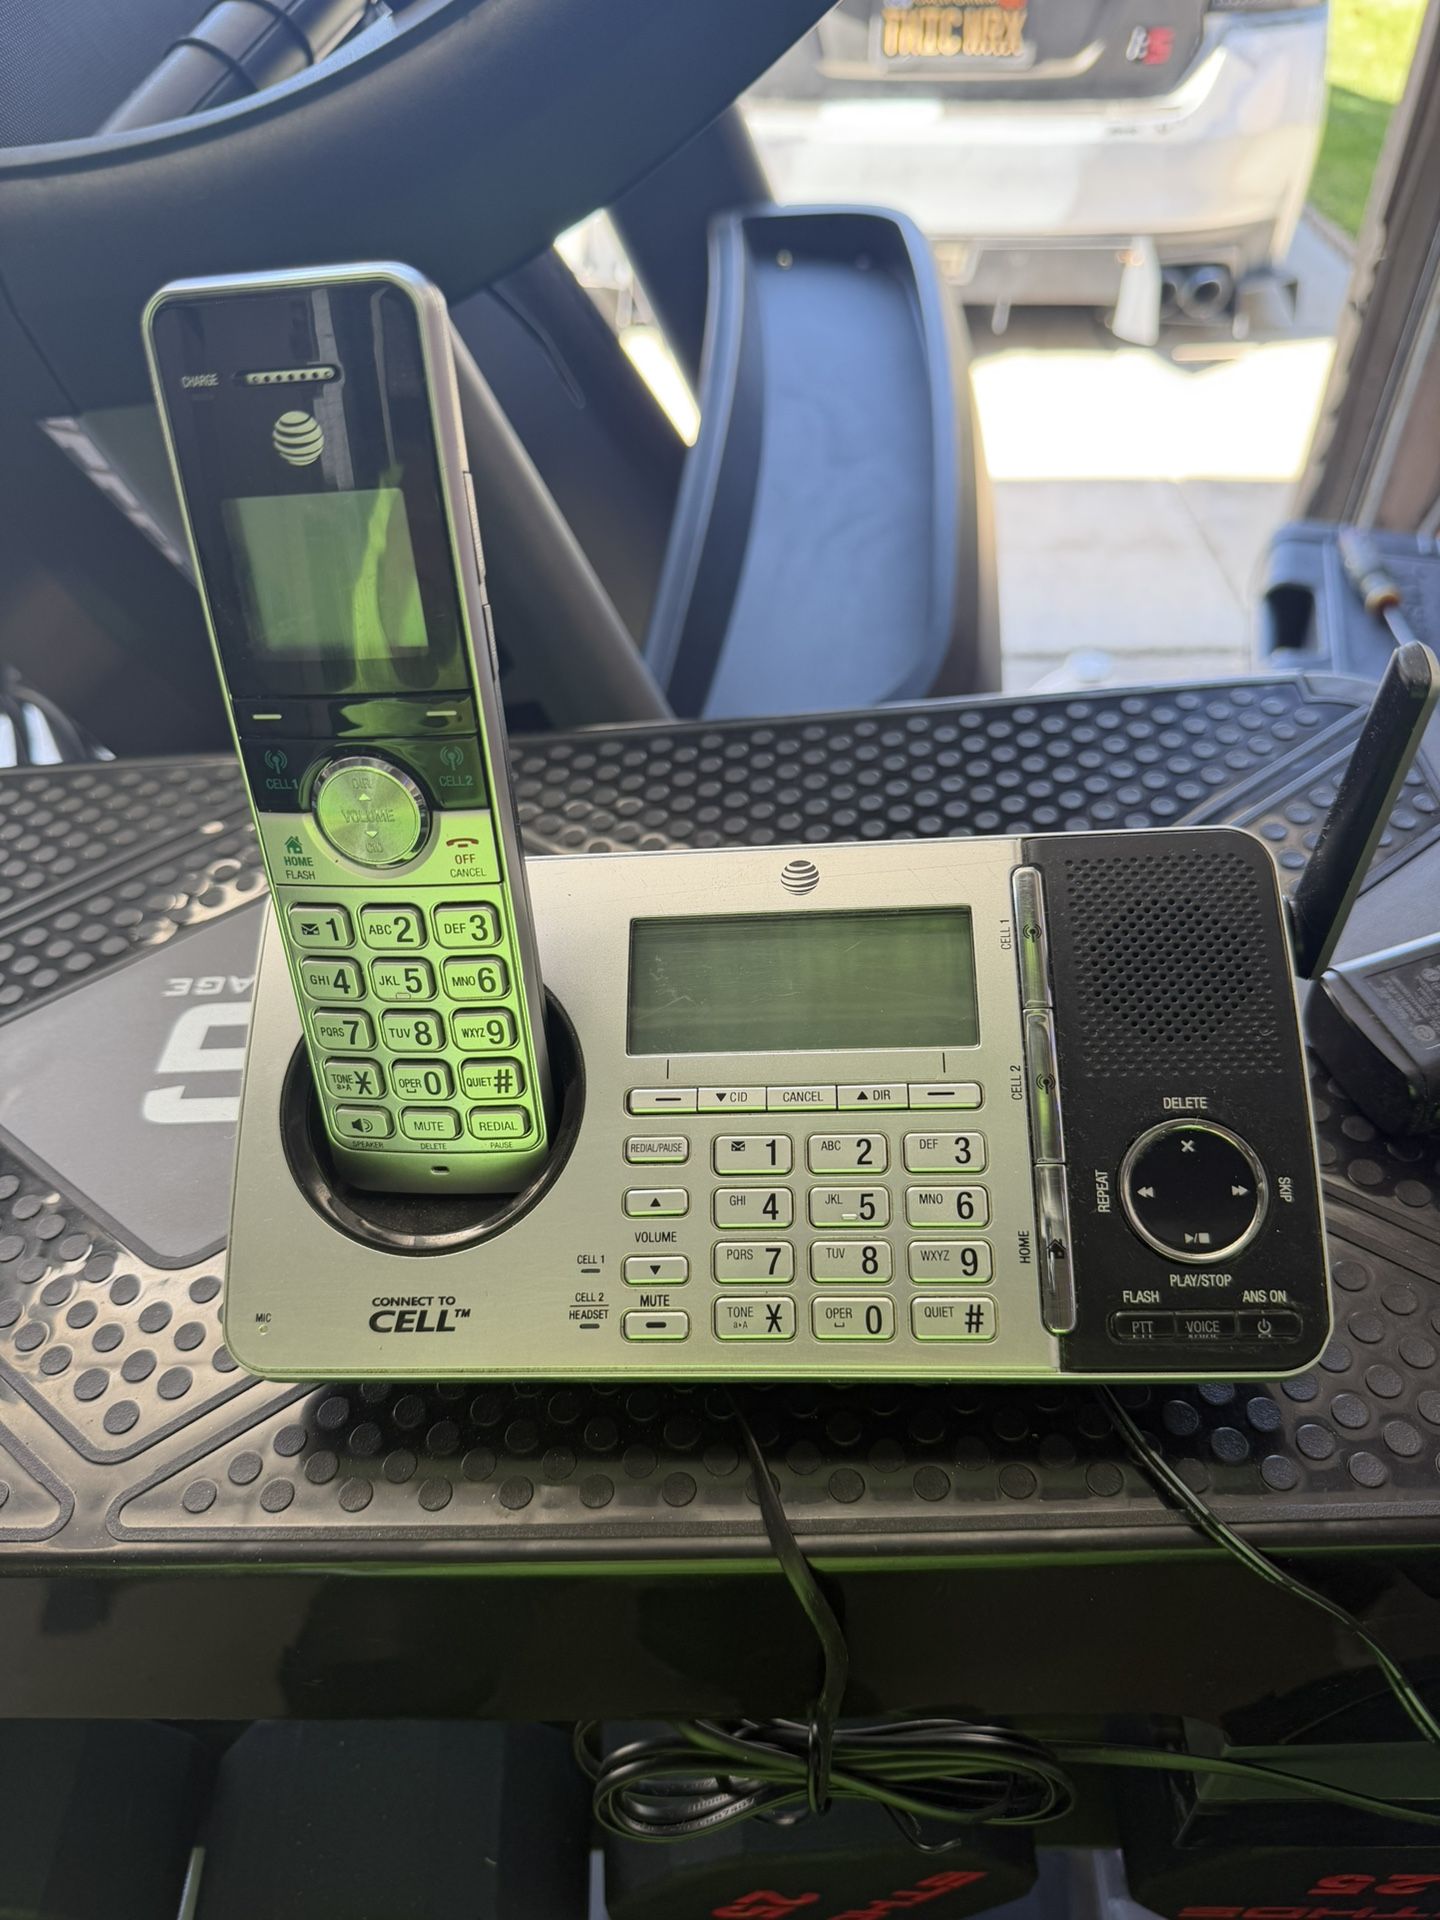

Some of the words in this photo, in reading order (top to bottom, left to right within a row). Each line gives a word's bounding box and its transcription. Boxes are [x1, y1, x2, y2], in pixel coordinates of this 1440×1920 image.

[181, 373, 219, 388] CHARGE
[341, 809, 395, 823] VOLUME
[284, 856, 313, 867] HOME
[455, 854, 476, 865] OFF
[286, 870, 315, 880] FLASH
[450, 868, 486, 878] CANCEL
[326, 918, 339, 941] 1
[369, 924, 392, 935] ABC
[393, 916, 414, 943] 2
[444, 923, 466, 934] DEF
[469, 915, 489, 941] 3
[1001, 928, 1012, 950] CELL
[162, 975, 255, 997] AGE
[310, 975, 330, 986] GHI
[333, 969, 350, 994] 4
[379, 975, 400, 986] JKL
[404, 968, 423, 993] 5
[452, 975, 476, 987] MNO
[477, 967, 497, 993] 6
[321, 1027, 345, 1038] PQRS
[343, 1021, 359, 1045] 7
[389, 1028, 410, 1038] TUV
[414, 1021, 433, 1046] 8
[461, 1027, 485, 1038] WXYZ
[486, 1020, 505, 1045] 9
[1010, 1065, 1021, 1073] 2
[331, 1074, 353, 1084] TONE
[399, 1078, 422, 1088] OPER
[424, 1071, 441, 1095] 0
[466, 1077, 492, 1087] QUIET
[494, 1069, 513, 1094] #
[873, 1089, 891, 1101] DIR
[1011, 1077, 1022, 1100] CELL
[730, 1091, 748, 1103] CID
[782, 1090, 824, 1103] CANCEL
[1162, 1097, 1208, 1110] DELETE
[414, 1121, 444, 1131] MUTE
[479, 1121, 518, 1131] REDIAL
[352, 1141, 384, 1149] SPEAKER
[420, 1142, 447, 1150] DELETE
[490, 1141, 512, 1149] PAUSE
[630, 1142, 683, 1154] REDIAL/PAUSE
[821, 1140, 841, 1152] ABC
[856, 1138, 873, 1166] 2
[919, 1138, 939, 1150] DEF
[954, 1137, 971, 1164] 3
[765, 1140, 777, 1166] 1
[1096, 1168, 1111, 1213] REPEAT
[1278, 1176, 1292, 1203] SKIP
[729, 1195, 746, 1207] GHI
[762, 1193, 779, 1220] 4
[824, 1194, 843, 1206] JKL
[859, 1193, 876, 1220] 5
[919, 1193, 943, 1205] MNO
[956, 1191, 974, 1219] 6
[634, 1231, 677, 1244] VOLUME
[1017, 1231, 1030, 1264] HOME
[577, 1255, 597, 1265] CELL
[726, 1248, 754, 1261] PQRS
[765, 1248, 782, 1276] 7
[826, 1248, 845, 1260] TUV
[861, 1246, 879, 1275] 8
[920, 1250, 950, 1262] WXYZ
[960, 1248, 979, 1276] 9
[1170, 1274, 1232, 1288] PLAY/STOP
[372, 1296, 434, 1307] CONNECT
[438, 1296, 456, 1306] TO
[575, 1293, 595, 1303] CELL
[598, 1292, 604, 1302] 2
[640, 1294, 670, 1307] MUTE
[1122, 1290, 1160, 1303] FLASH
[1242, 1290, 1266, 1303] ANS
[1270, 1290, 1286, 1302] ON
[255, 1312, 272, 1323] MIC
[568, 1309, 609, 1320] HEADSET
[727, 1306, 754, 1319] TONE
[825, 1307, 853, 1320] OPER
[865, 1305, 882, 1334] 0
[924, 1306, 955, 1318] QUIET
[964, 1304, 984, 1333] #
[1132, 1320, 1154, 1333] PTT
[1186, 1320, 1220, 1333] VOICE
[1178, 1906, 1440, 1919] THOS
